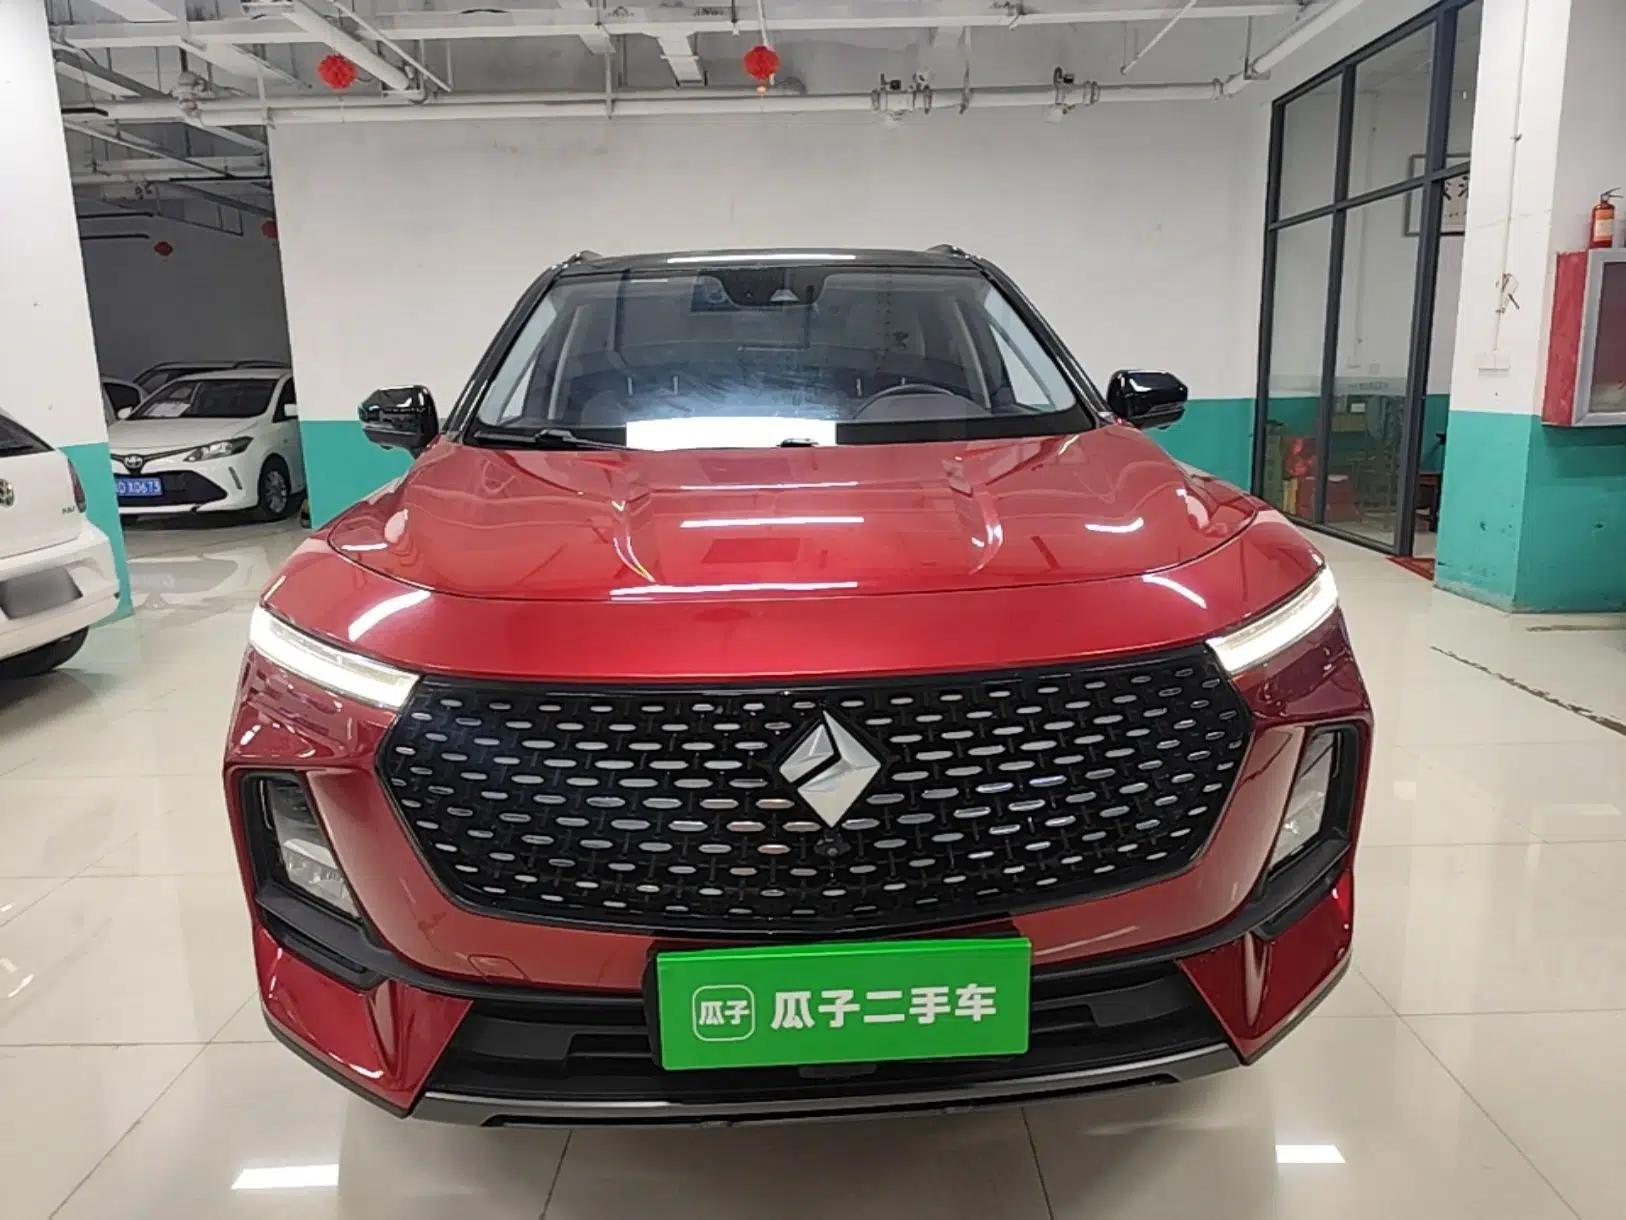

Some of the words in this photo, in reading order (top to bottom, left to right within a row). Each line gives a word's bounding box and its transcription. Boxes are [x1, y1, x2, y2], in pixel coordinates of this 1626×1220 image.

[699, 1000, 749, 1024] 瓜子
[771, 984, 996, 1029] 瓜子二手车
